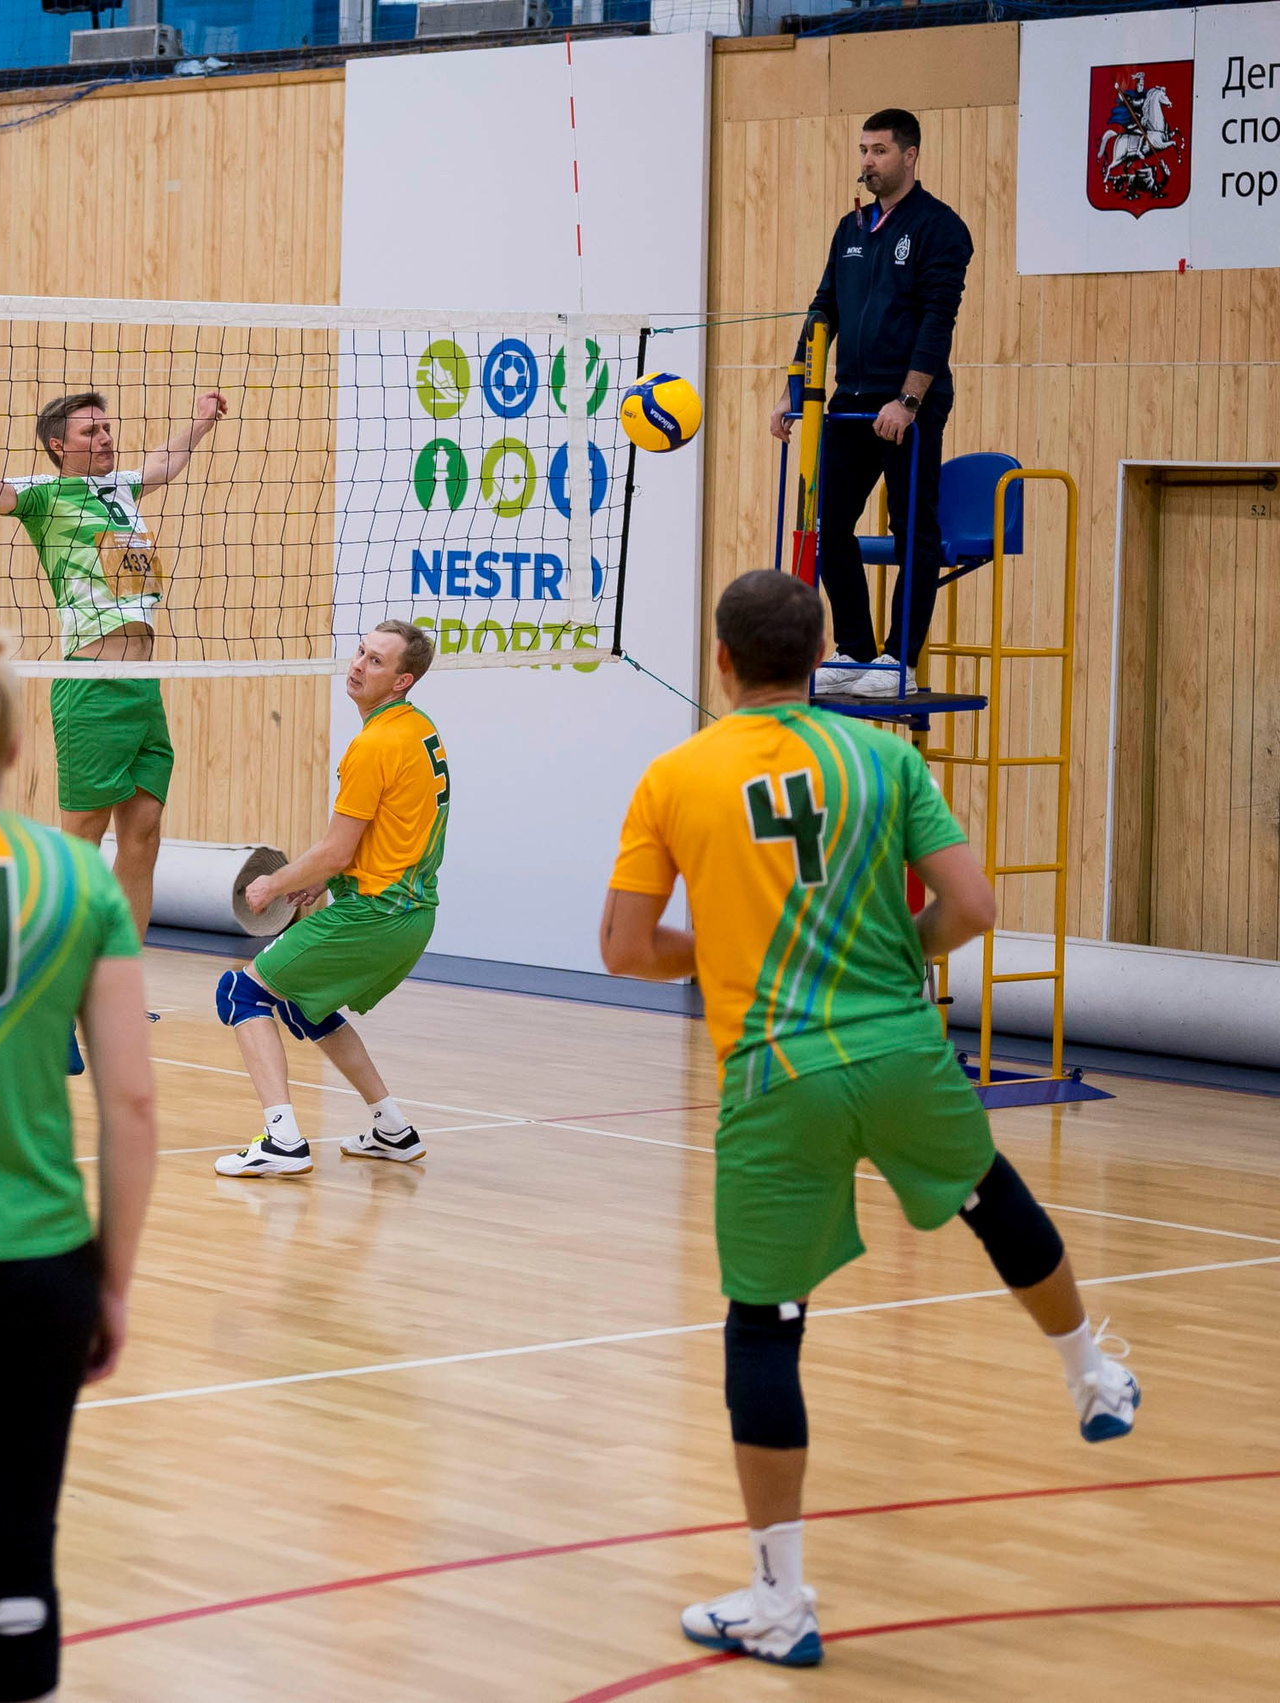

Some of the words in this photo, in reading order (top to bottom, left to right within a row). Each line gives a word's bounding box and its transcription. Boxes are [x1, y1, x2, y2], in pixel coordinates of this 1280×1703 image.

[1222, 117, 1280, 145] спо
[1222, 171, 1278, 206] гор
[97, 486, 131, 526] 6
[123, 554, 151, 572] 433
[422, 732, 450, 808] 5
[742, 768, 828, 887] 4
